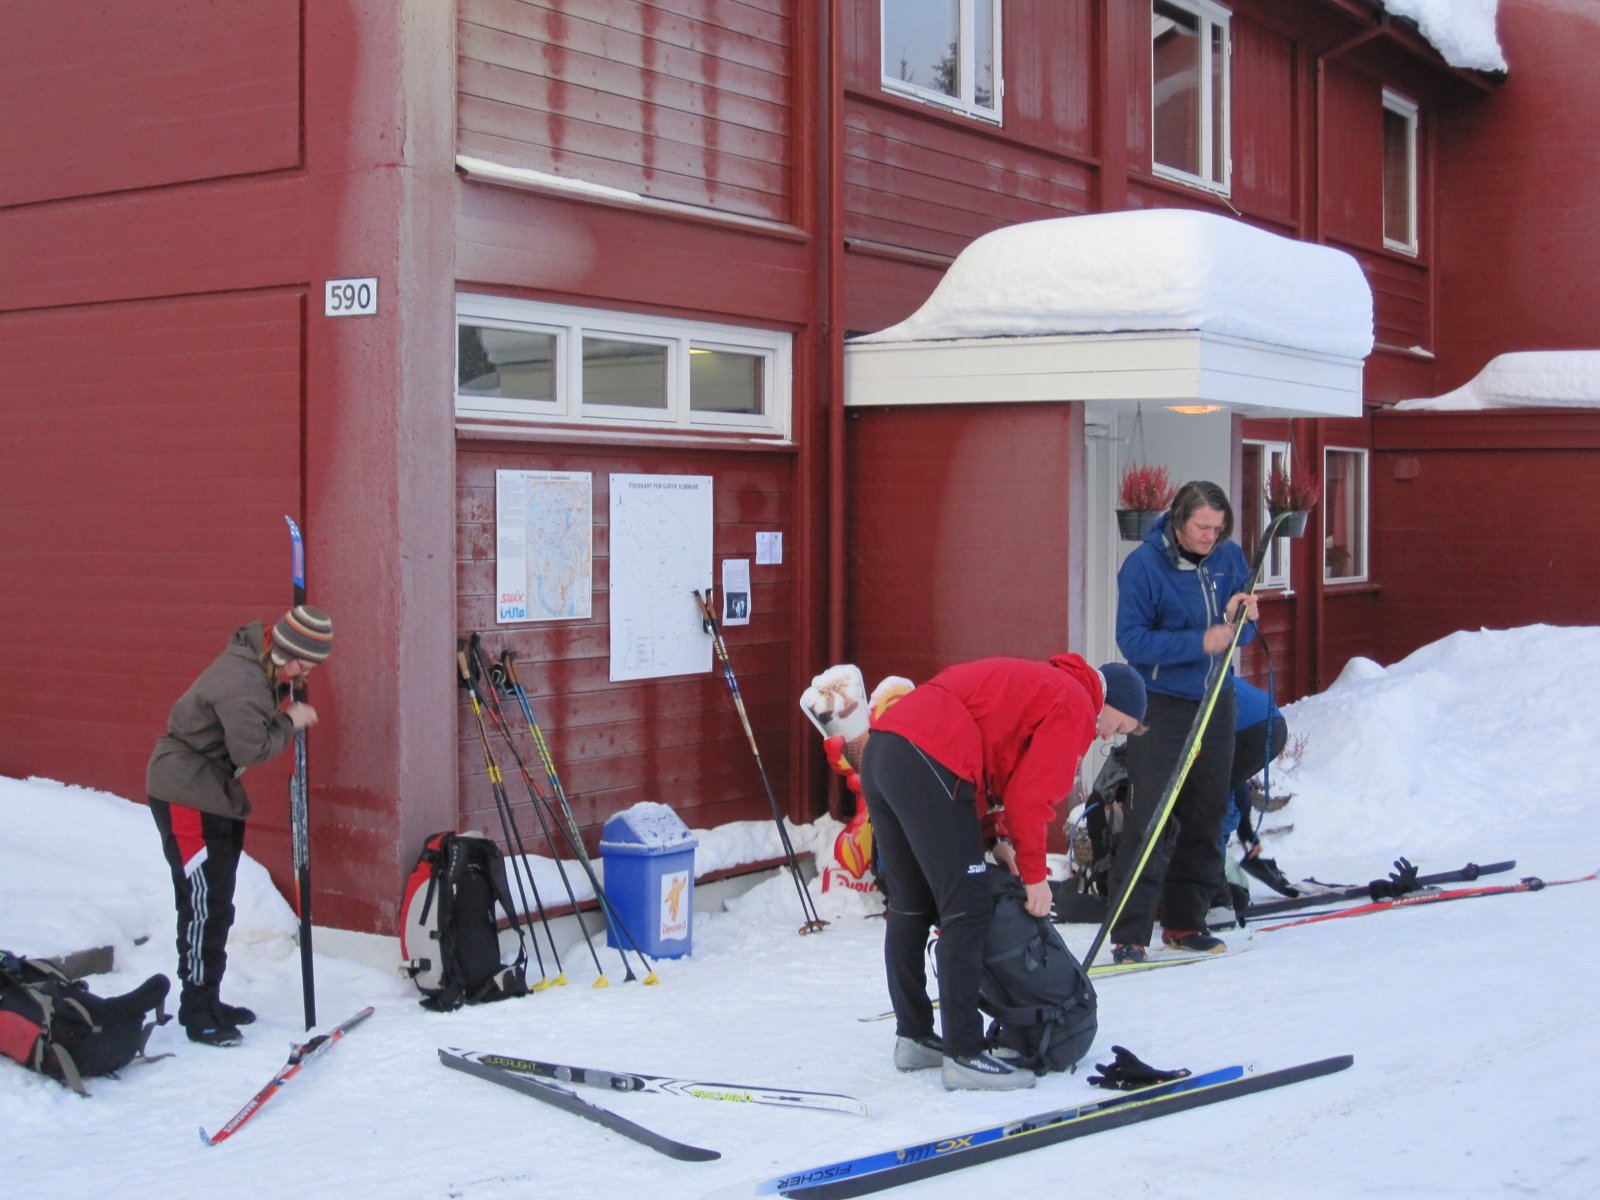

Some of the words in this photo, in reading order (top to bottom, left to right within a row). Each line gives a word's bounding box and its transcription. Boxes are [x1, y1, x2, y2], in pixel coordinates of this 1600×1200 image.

[331, 283, 371, 310] 590
[969, 1059, 1000, 1073] alpina
[934, 1134, 975, 1154] XC
[776, 1163, 853, 1190] FISCHER
